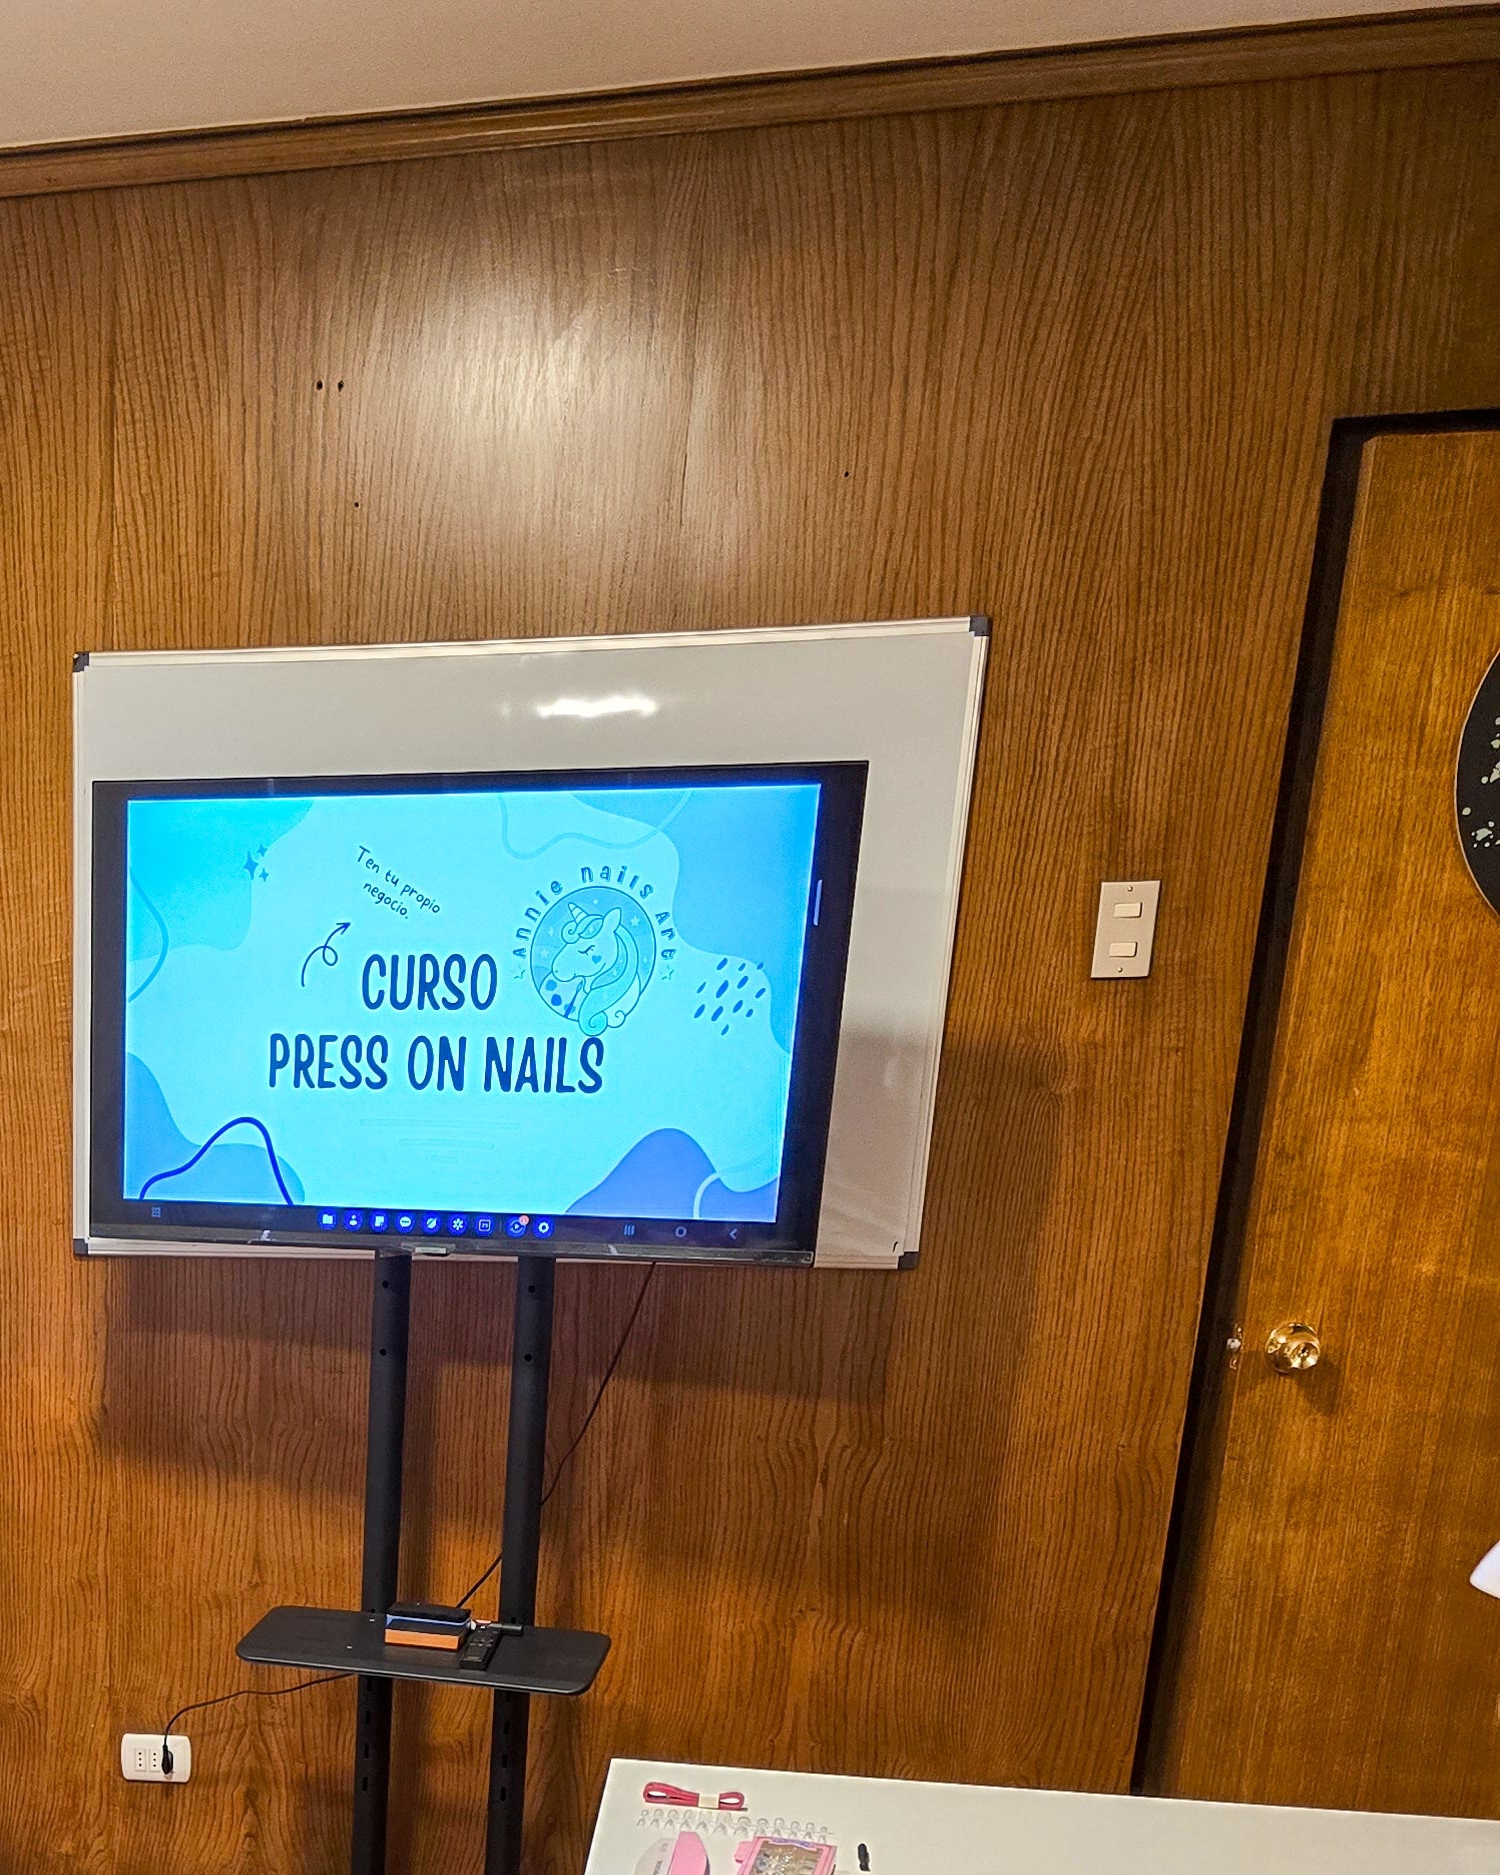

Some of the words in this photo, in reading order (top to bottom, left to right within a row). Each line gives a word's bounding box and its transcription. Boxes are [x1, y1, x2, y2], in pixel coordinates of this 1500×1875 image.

[357, 845, 380, 874] Ten
[384, 869, 400, 888] tu
[400, 884, 441, 914] propio
[363, 882, 409, 920] negocio.
[581, 865, 654, 899] nails
[655, 911, 676, 960] Art
[362, 953, 498, 1011] CURSO
[268, 1033, 389, 1090] PRESS
[407, 1035, 467, 1092] ON
[483, 1036, 605, 1094] NAILS
